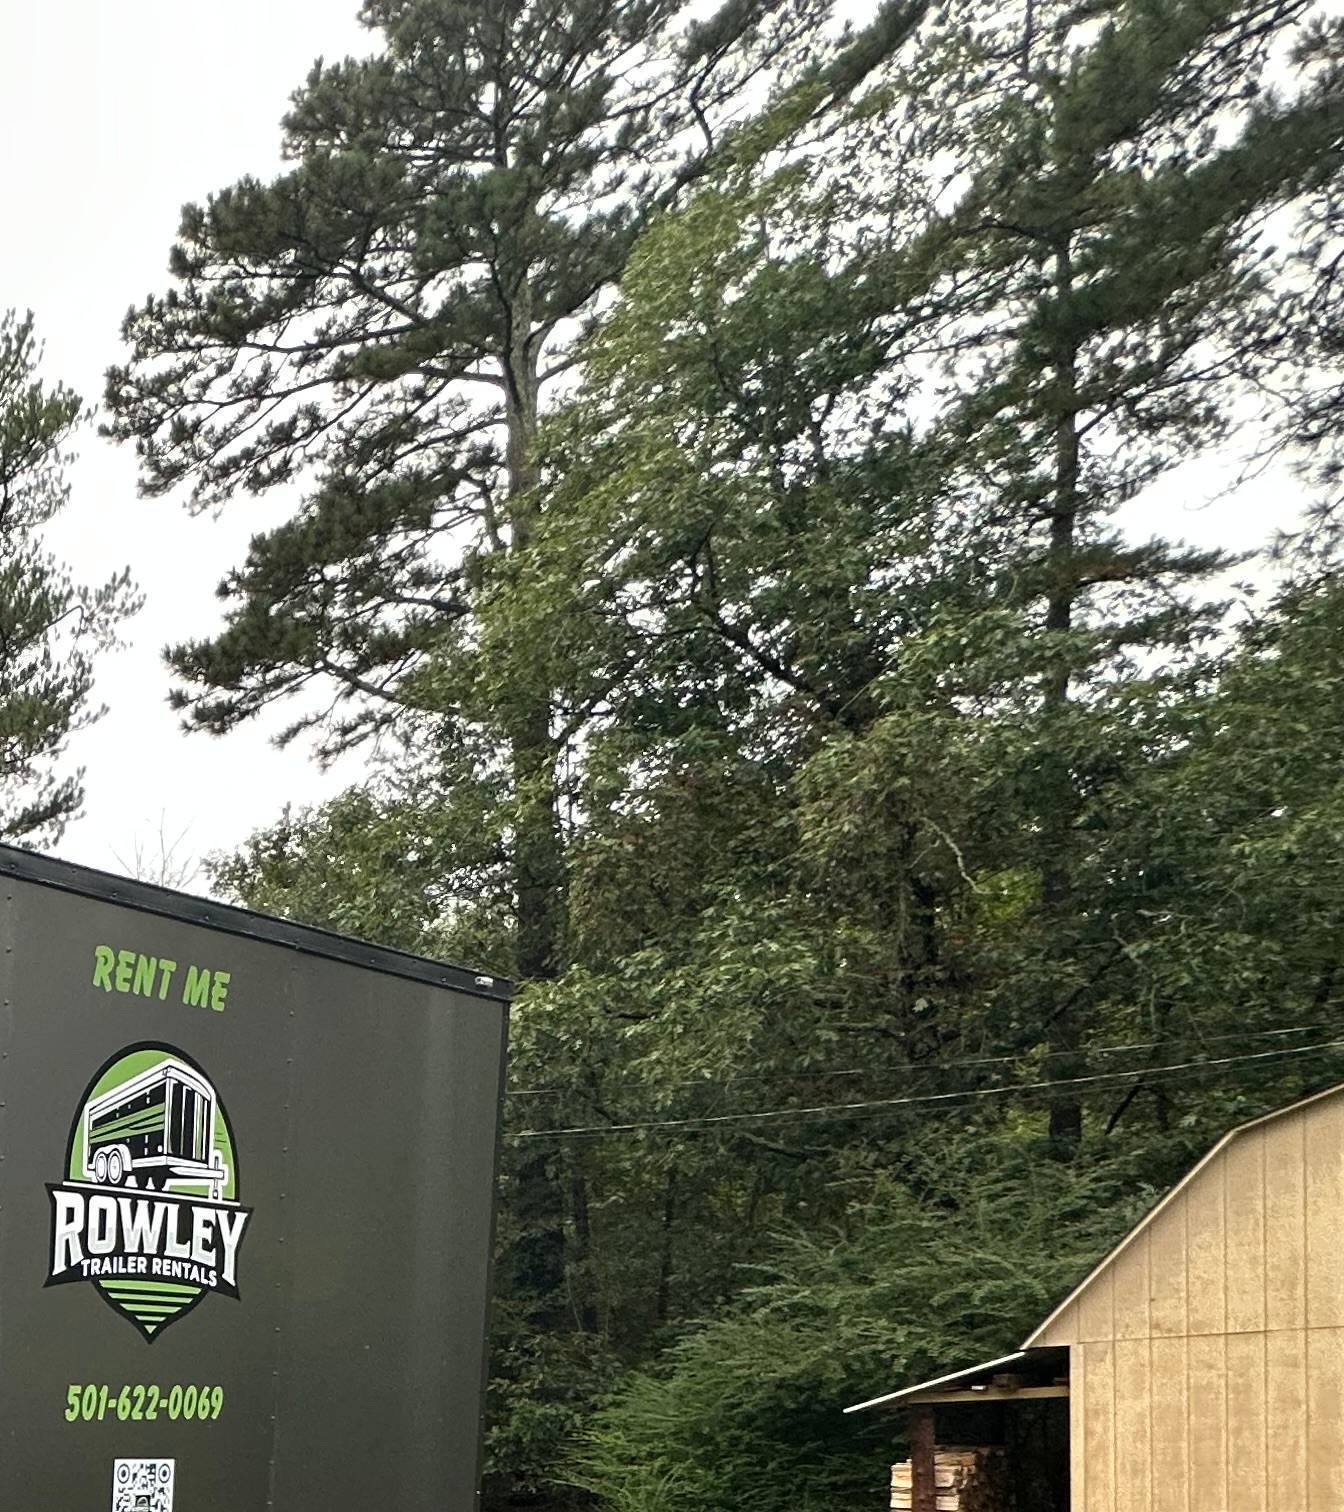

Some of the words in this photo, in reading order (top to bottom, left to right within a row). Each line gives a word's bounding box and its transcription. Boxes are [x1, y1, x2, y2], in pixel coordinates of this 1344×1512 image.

[92, 945, 177, 1000] RENT
[182, 965, 231, 1011] ME
[52, 1190, 248, 1287] ROWLEY
[81, 1256, 147, 1277] TRAILER
[152, 1257, 217, 1287] RENTALS
[65, 1384, 224, 1421] 501-622-0069
